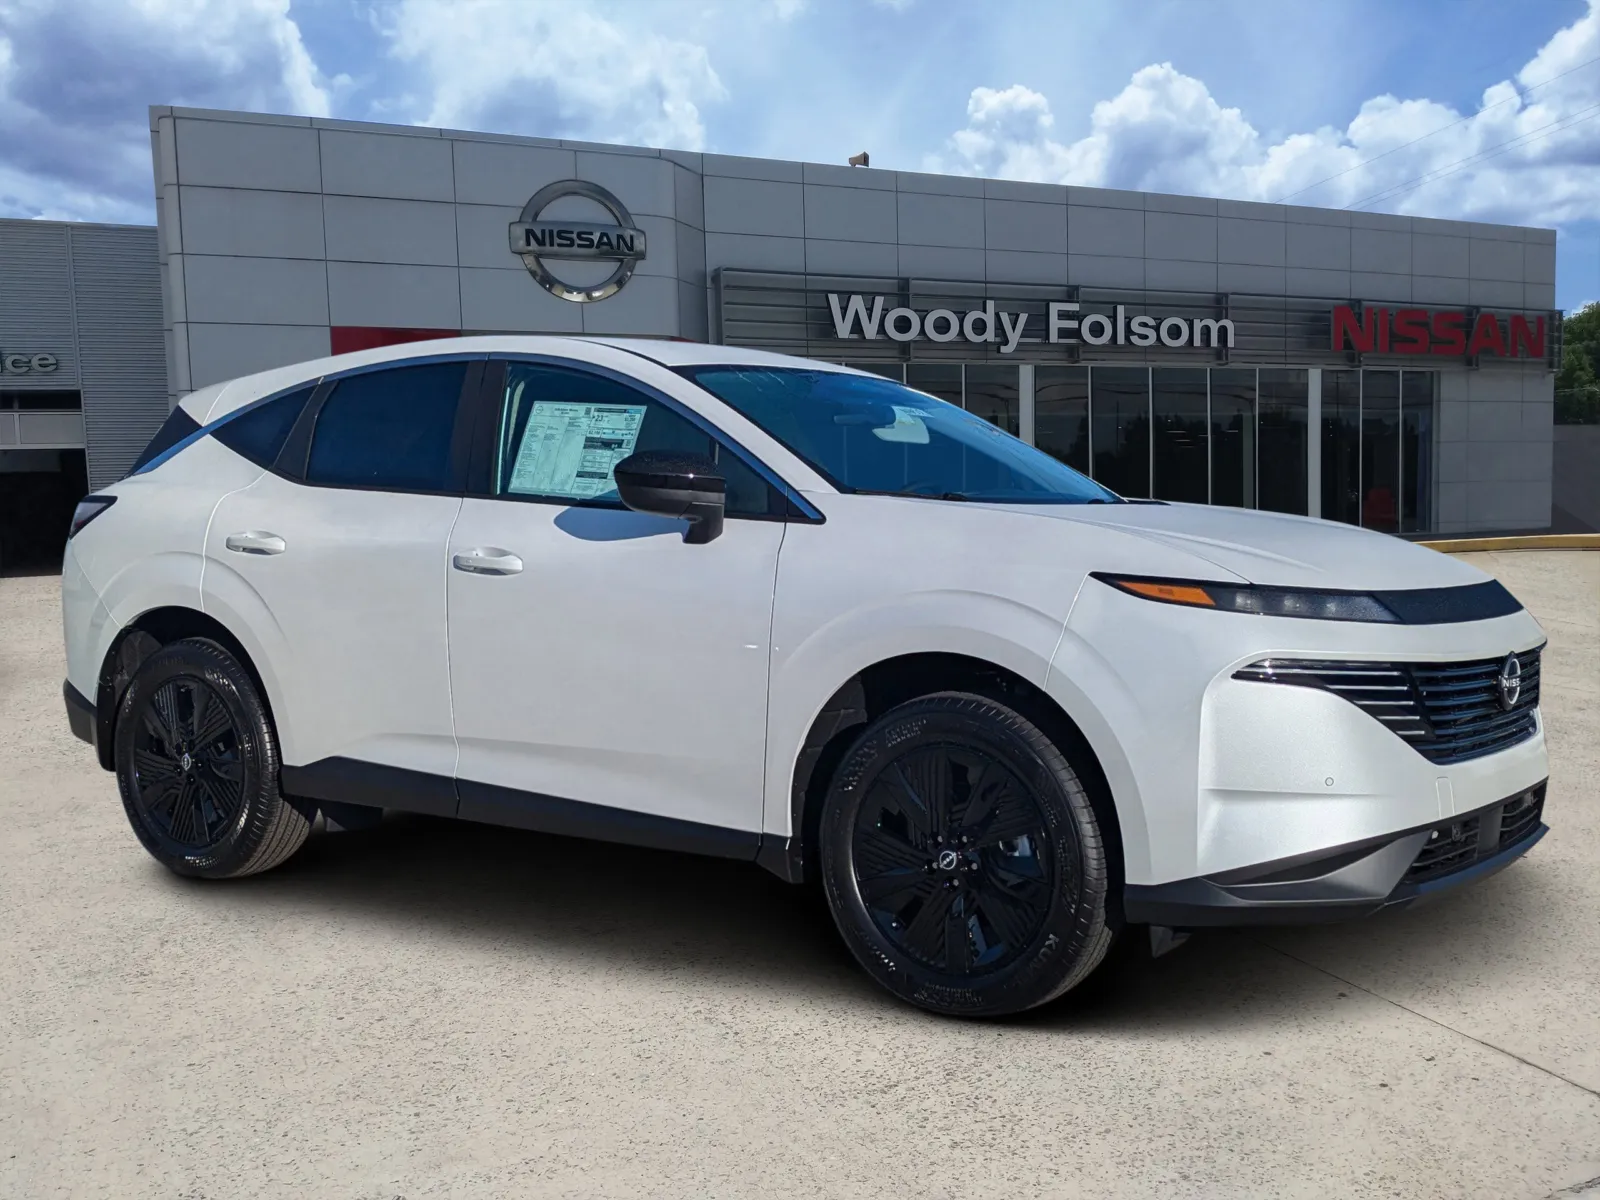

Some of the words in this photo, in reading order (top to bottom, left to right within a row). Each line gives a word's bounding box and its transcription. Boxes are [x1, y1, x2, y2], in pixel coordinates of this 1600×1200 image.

[525, 229, 634, 252] NISSAN
[827, 293, 1028, 354] Woody
[1048, 302, 1235, 348] Folsom
[1331, 305, 1546, 358] NISSAN
